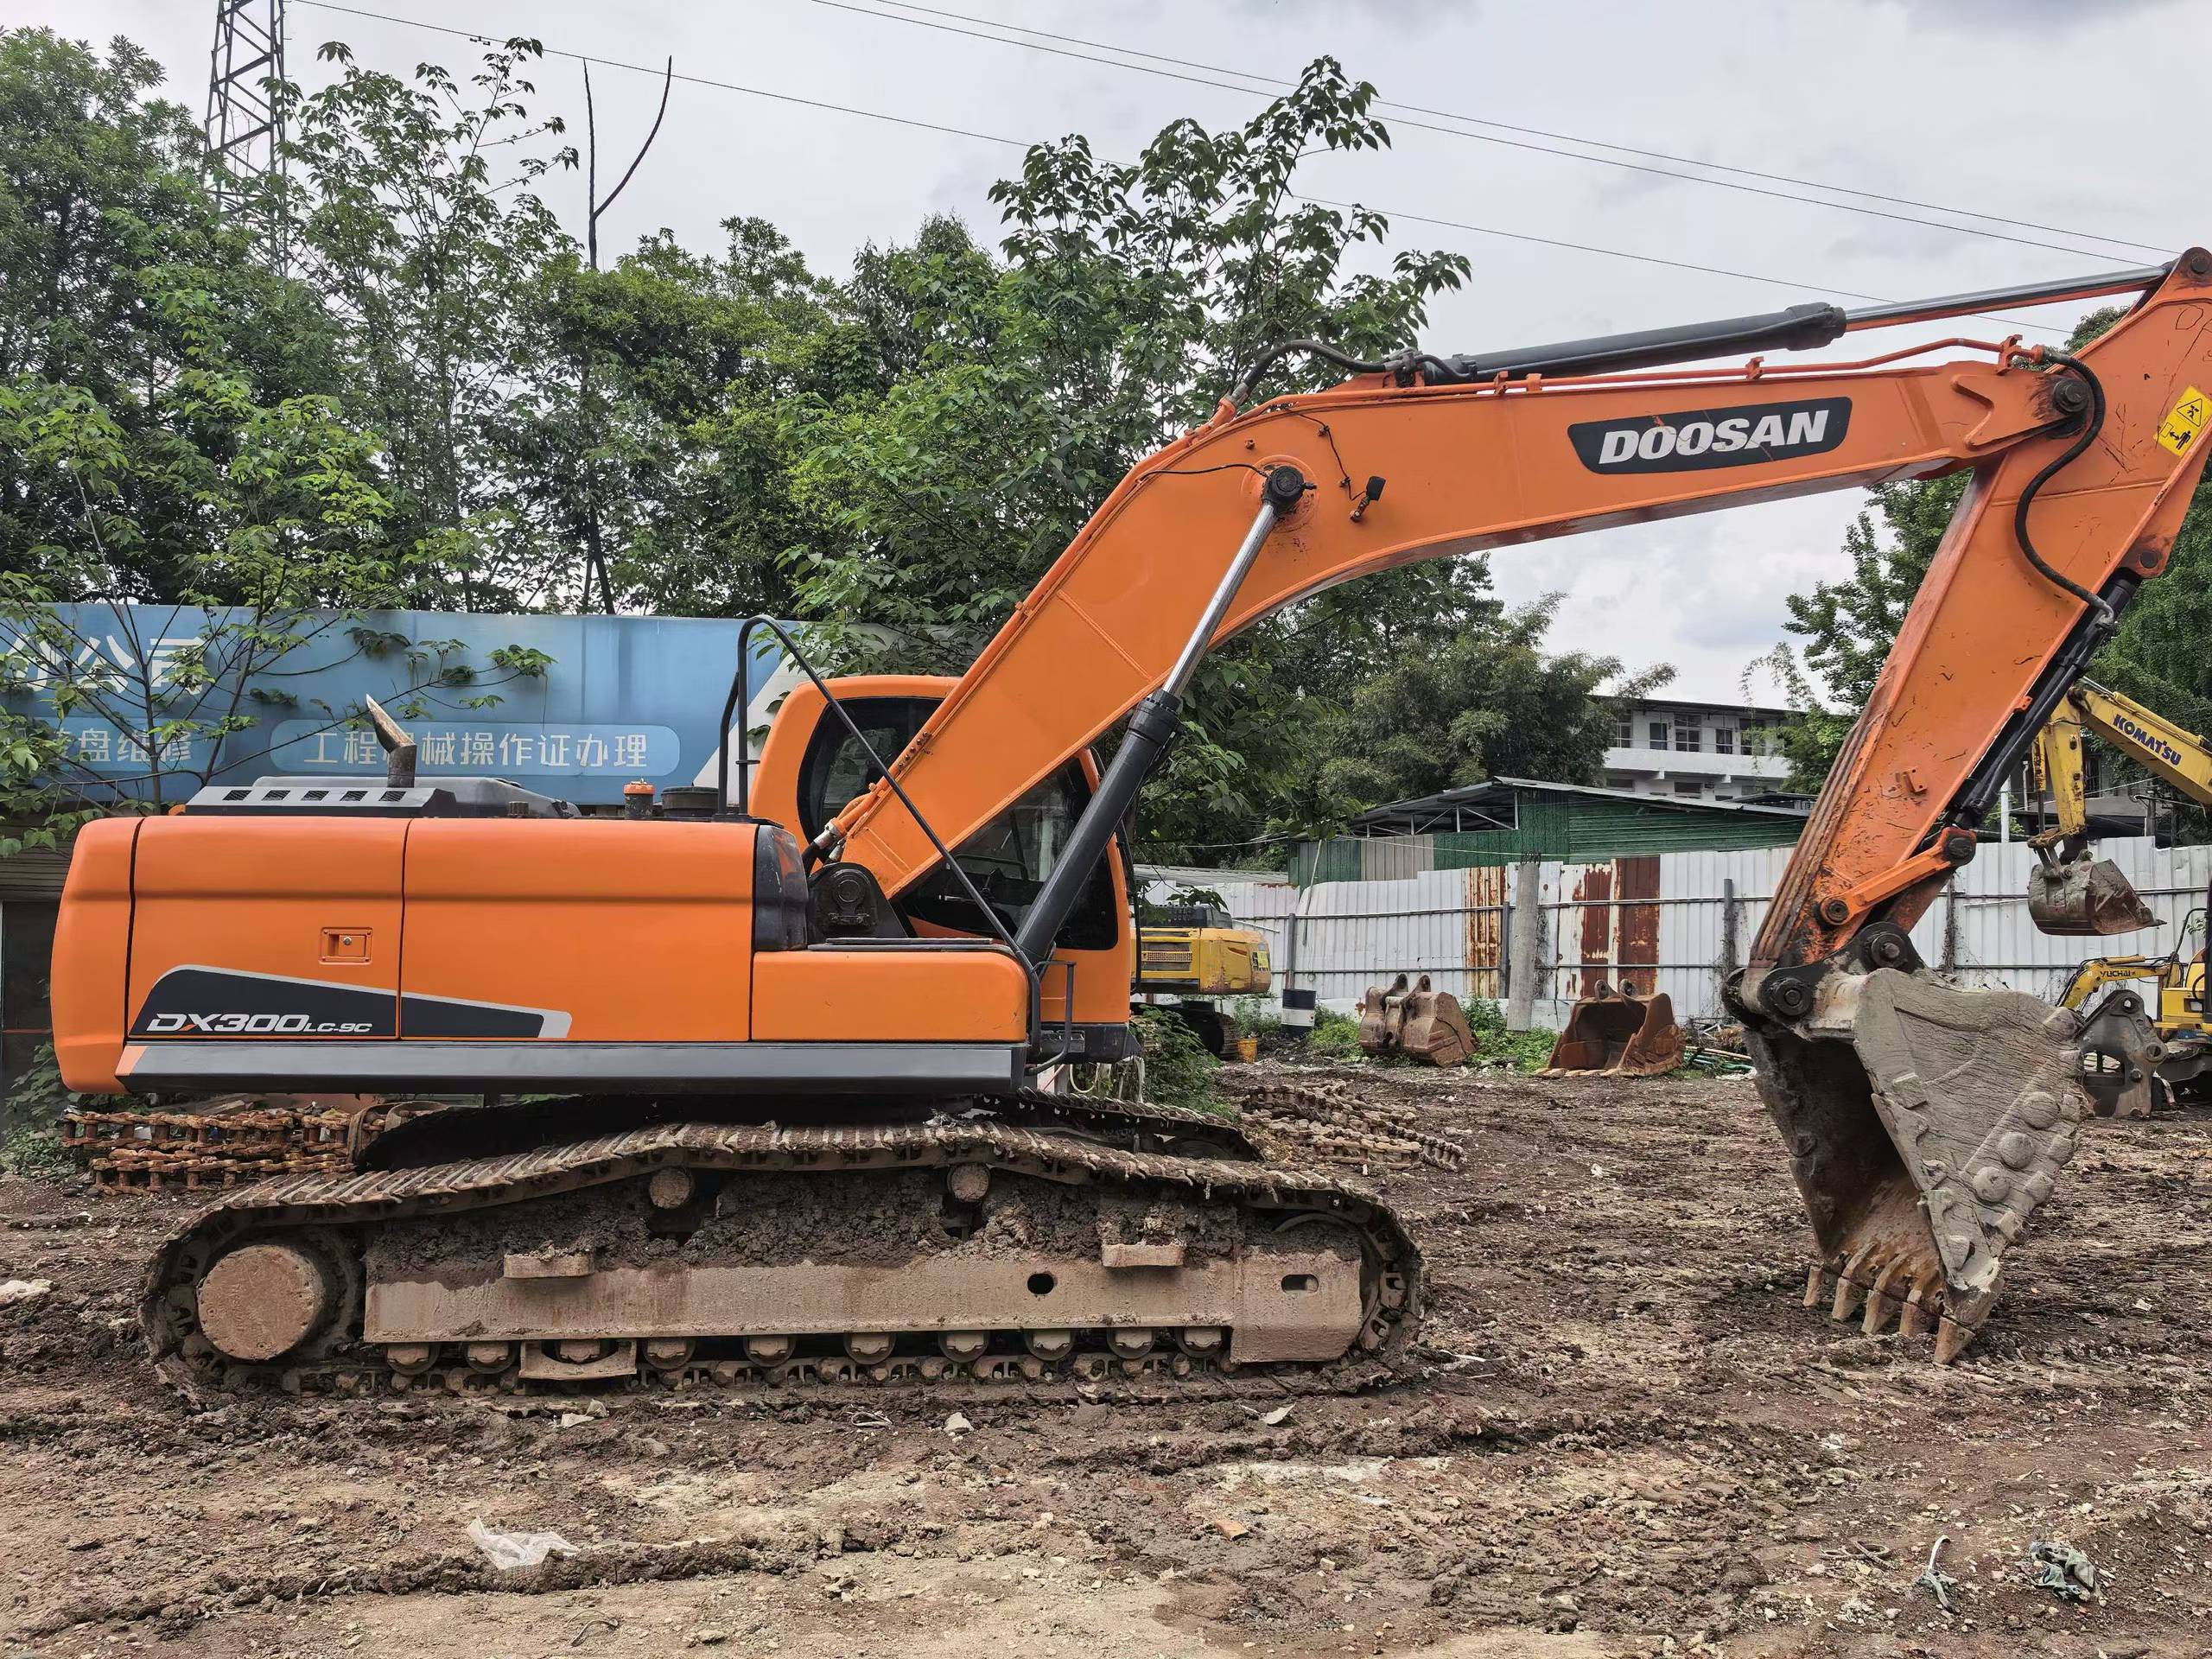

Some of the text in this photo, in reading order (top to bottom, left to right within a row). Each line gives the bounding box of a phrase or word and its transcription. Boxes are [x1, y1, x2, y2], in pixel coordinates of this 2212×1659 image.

[1599, 410, 1829, 464] DOOSAN
[54, 728, 193, 762] 盘维修
[304, 732, 647, 767] 工程械操作证办理
[2113, 714, 2182, 766] KOMATSU
